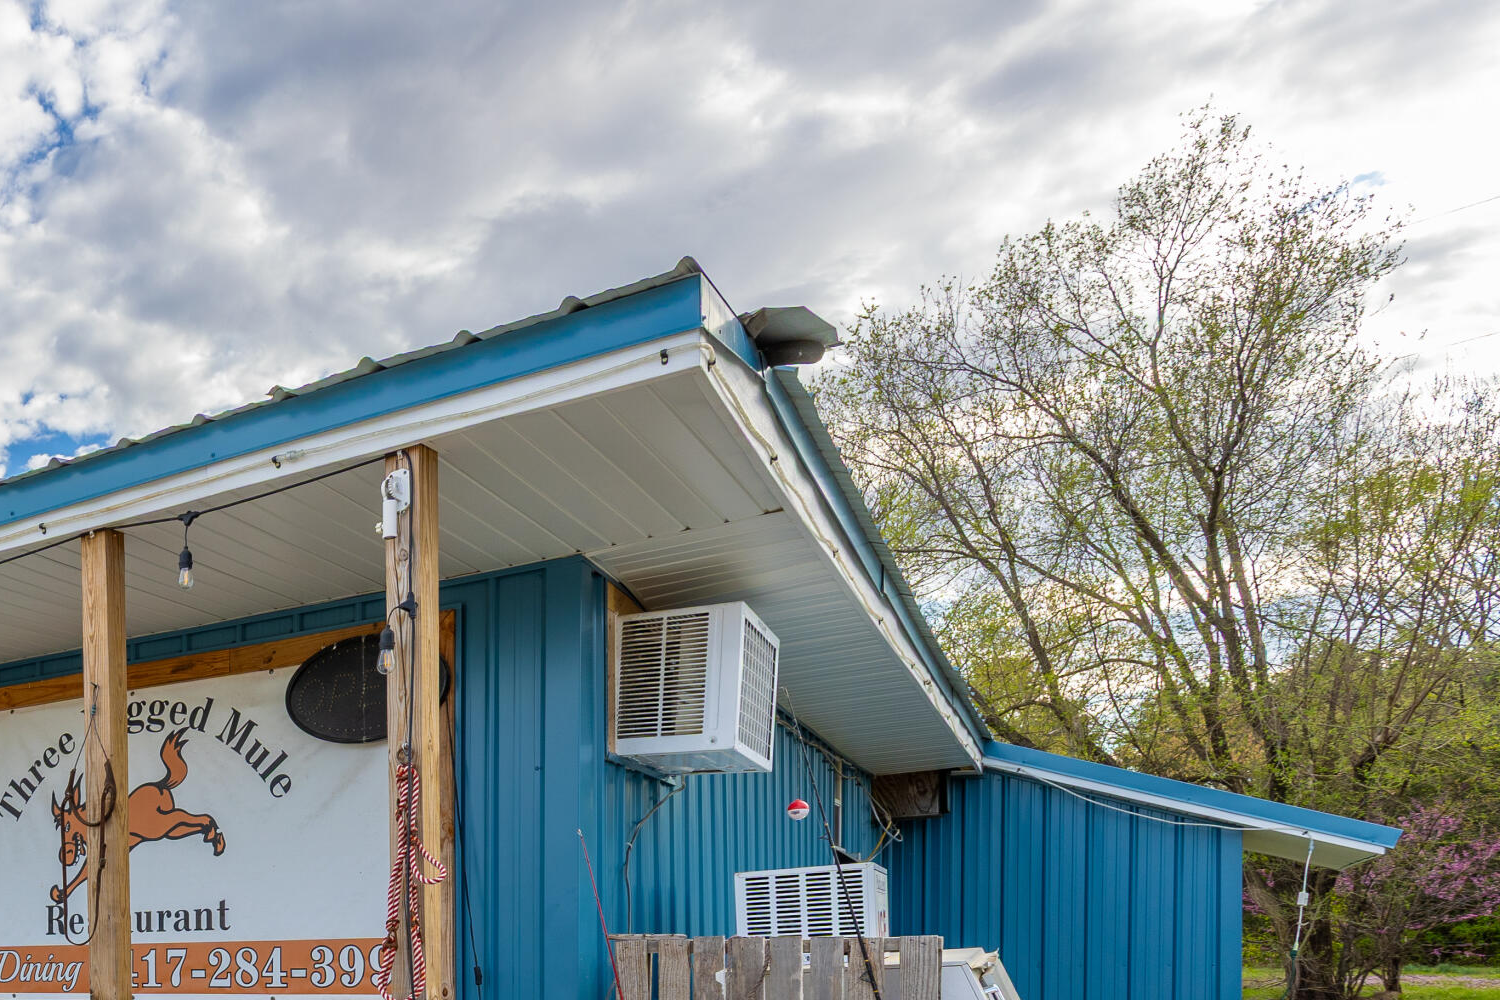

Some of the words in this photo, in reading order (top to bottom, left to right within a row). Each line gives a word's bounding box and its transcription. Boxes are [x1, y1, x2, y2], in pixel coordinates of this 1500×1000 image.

[298, 667, 383, 716] OPE
[81, 697, 214, 734] gged
[215, 707, 292, 799] Mule
[46, 899, 231, 936] Reurant
[131, 944, 393, 989] 17-284-399
